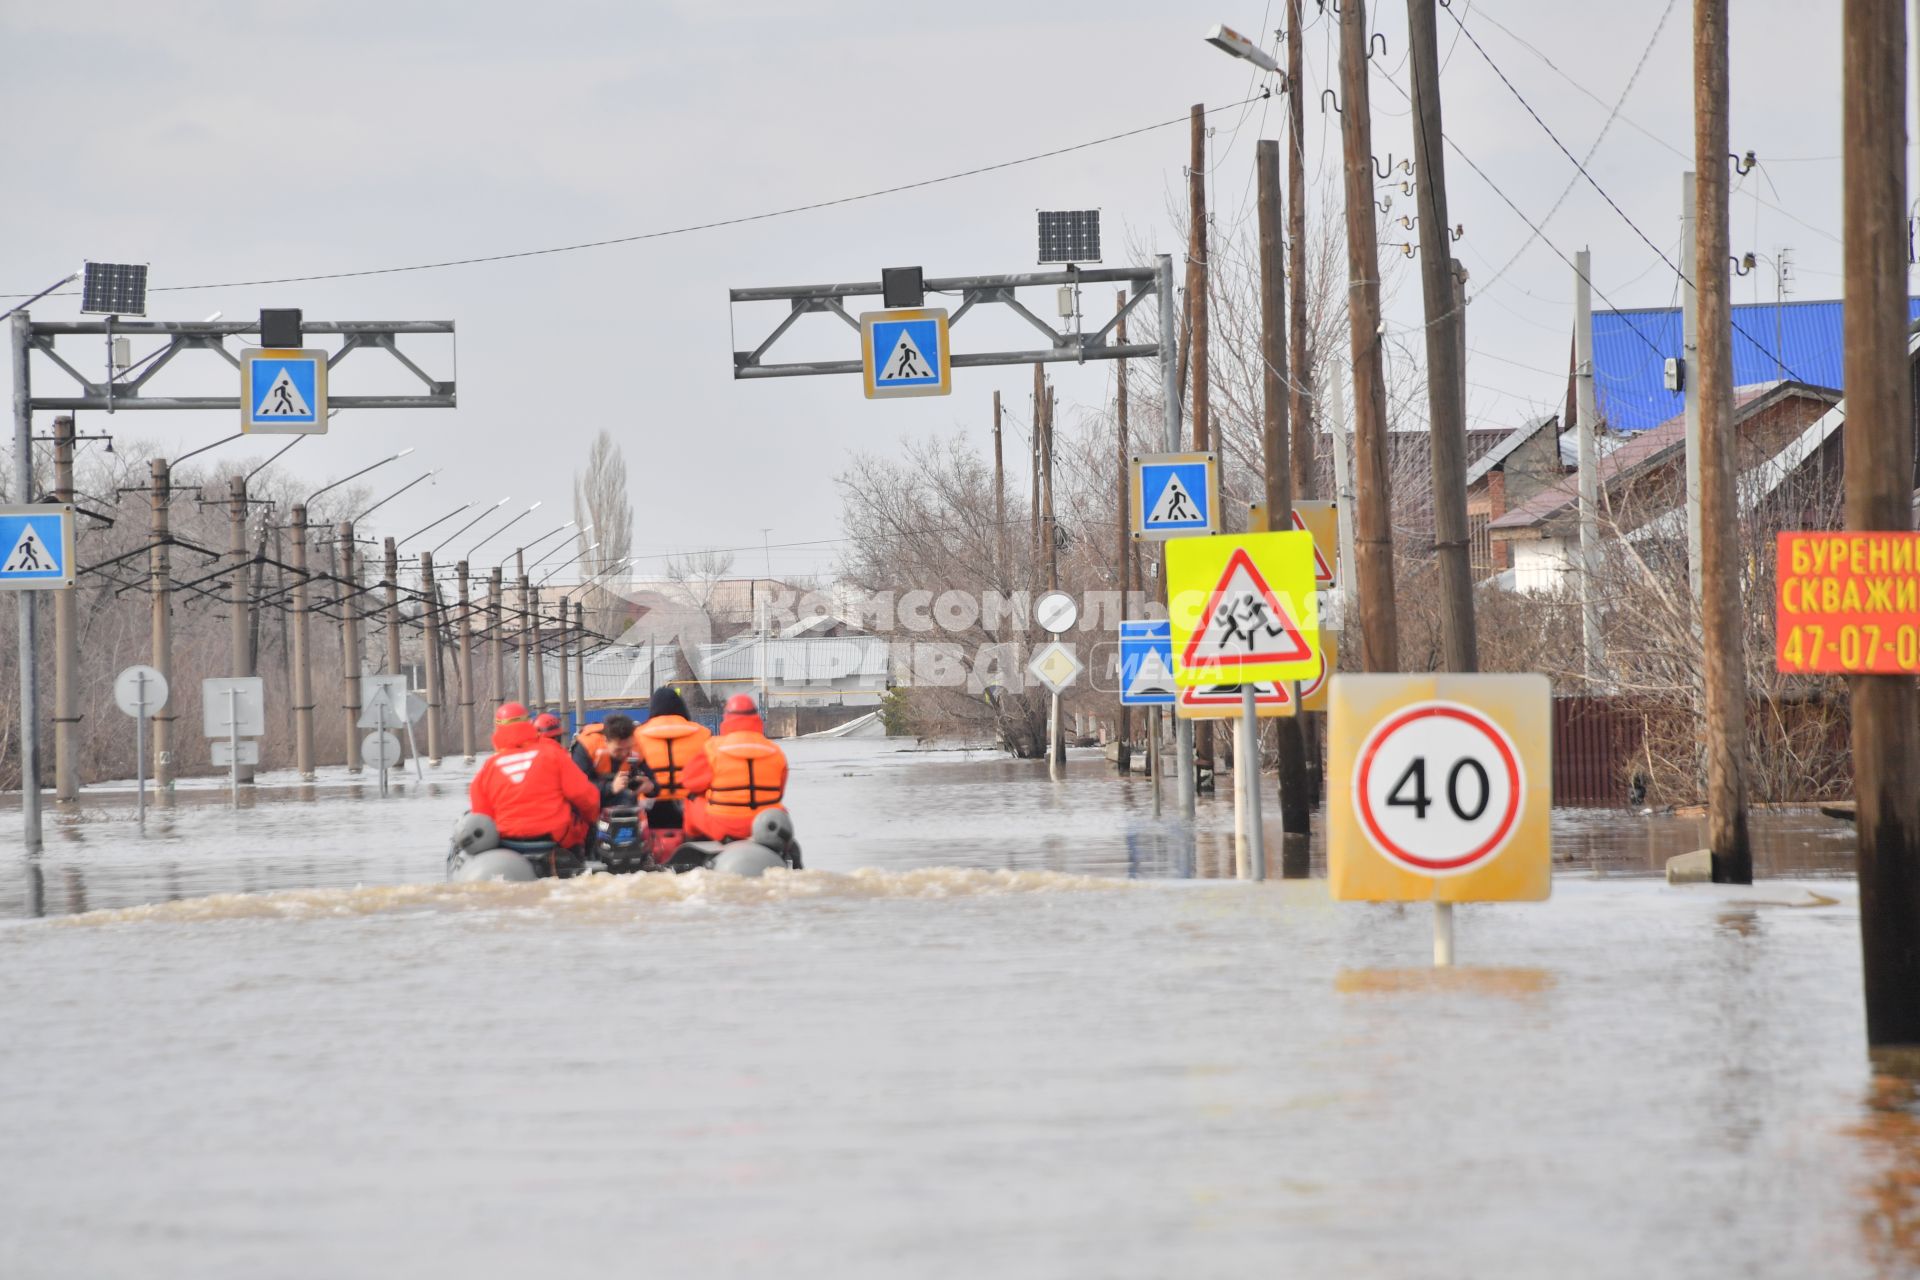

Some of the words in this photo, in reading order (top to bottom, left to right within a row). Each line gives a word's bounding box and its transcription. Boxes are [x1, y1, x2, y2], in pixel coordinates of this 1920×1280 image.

[1782, 576, 1920, 614] СКВАЖИ
[1783, 624, 1920, 671] 47-07-0
[1385, 756, 1490, 822] 40
